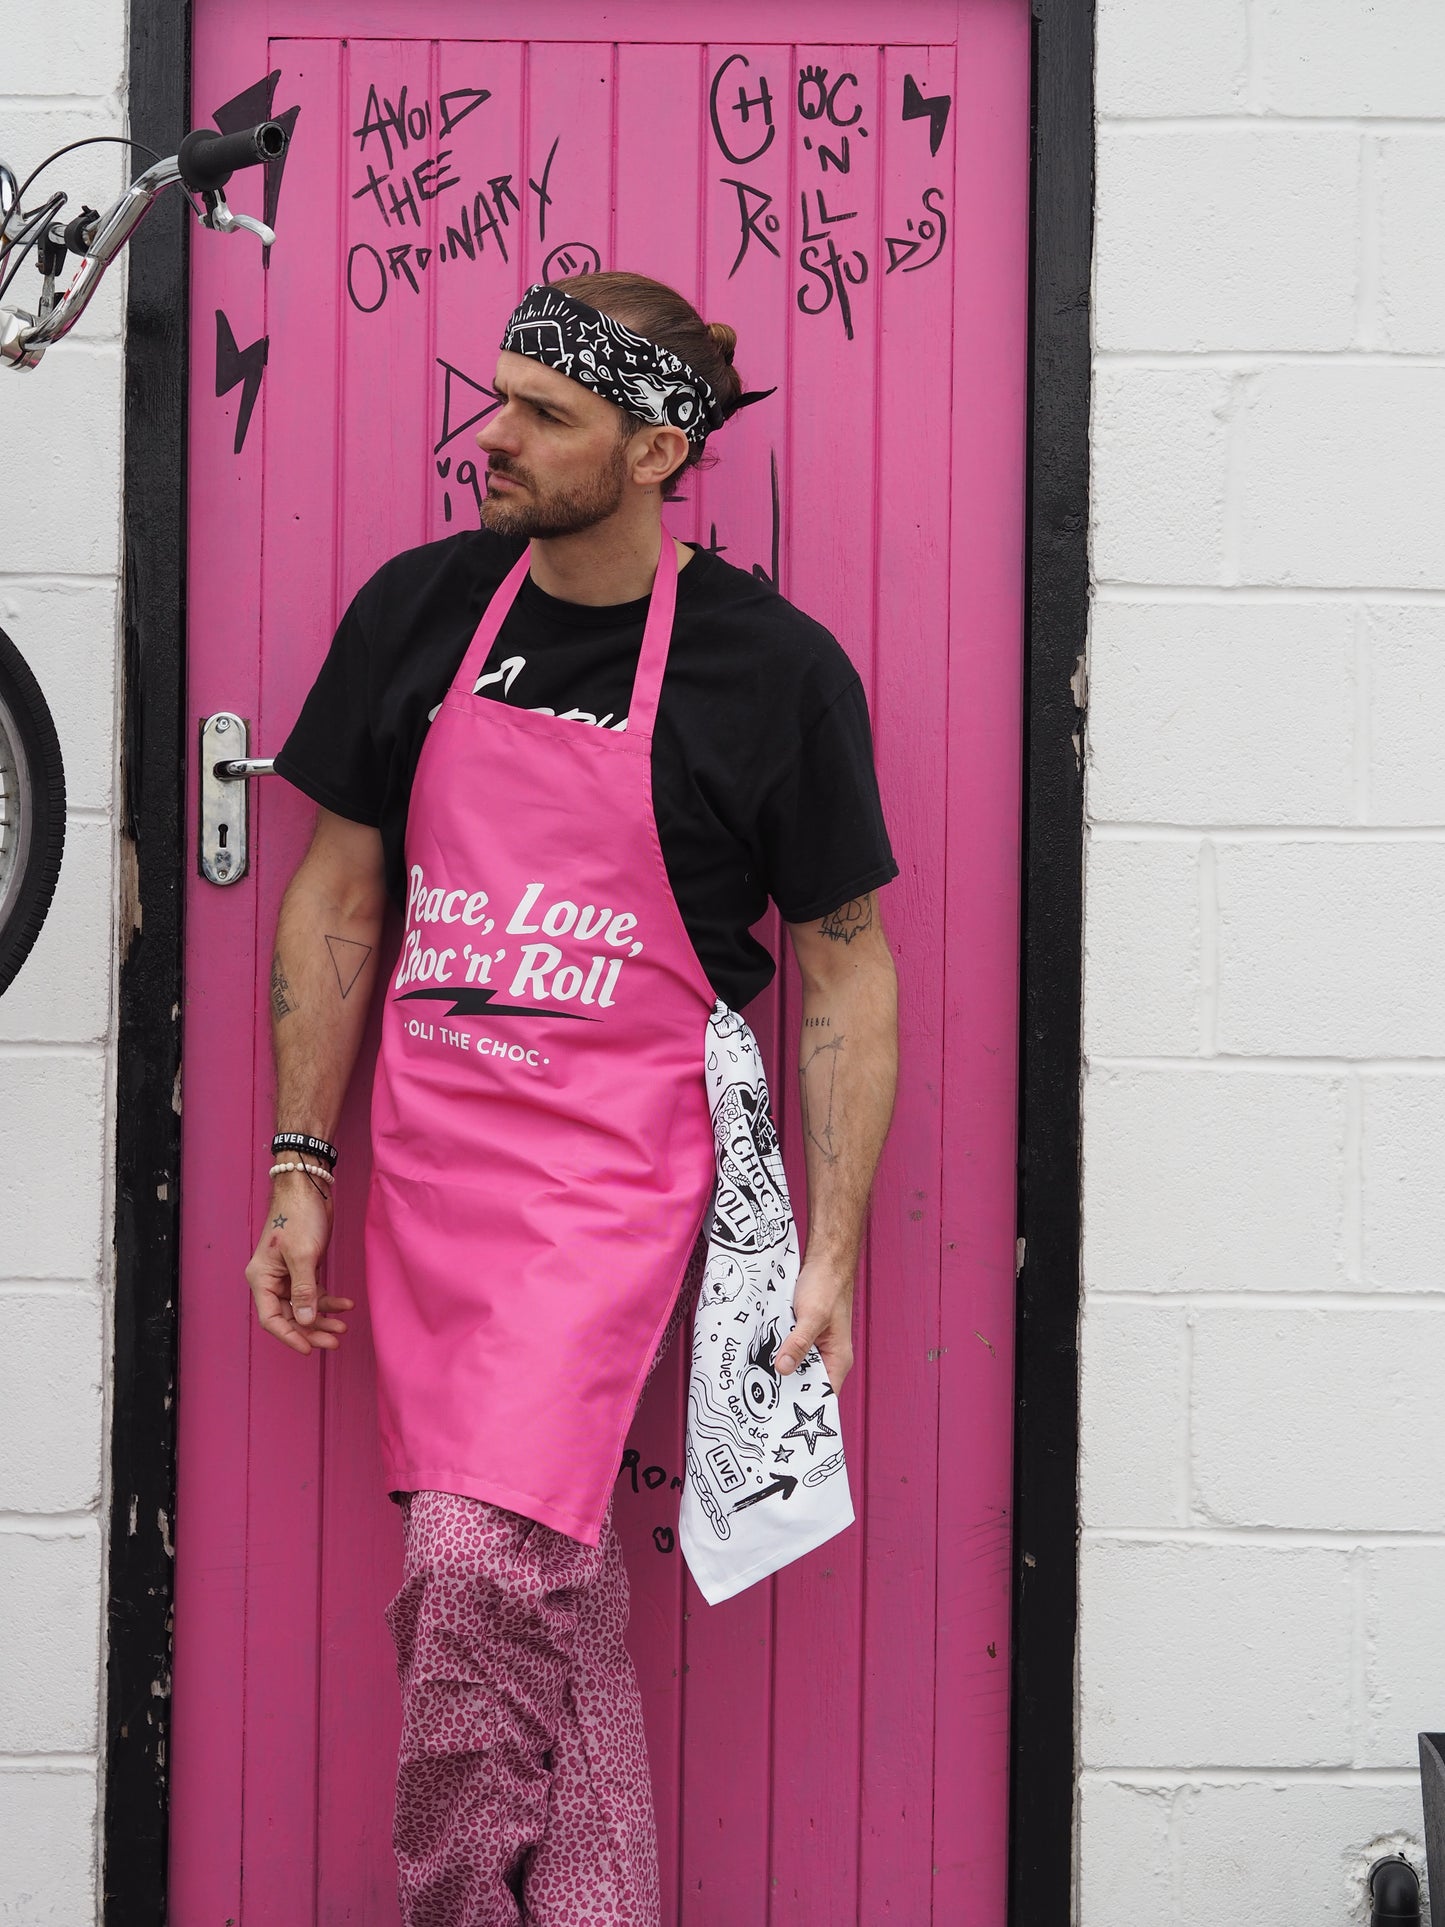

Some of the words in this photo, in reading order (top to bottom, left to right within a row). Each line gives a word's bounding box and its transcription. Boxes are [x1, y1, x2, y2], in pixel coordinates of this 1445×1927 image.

[353, 84, 492, 169] AVOID
[405, 864, 495, 935] Peace,
[506, 883, 644, 957] Love,
[395, 930, 457, 990] Choc
[509, 943, 624, 1008] Roll
[439, 1027, 471, 1051] THE
[273, 1133, 305, 1145] NEVER
[308, 1137, 329, 1153] GIVE
[731, 1135, 775, 1208] CHOC
[719, 1337, 742, 1391] waves
[712, 1450, 739, 1488] LIVE
